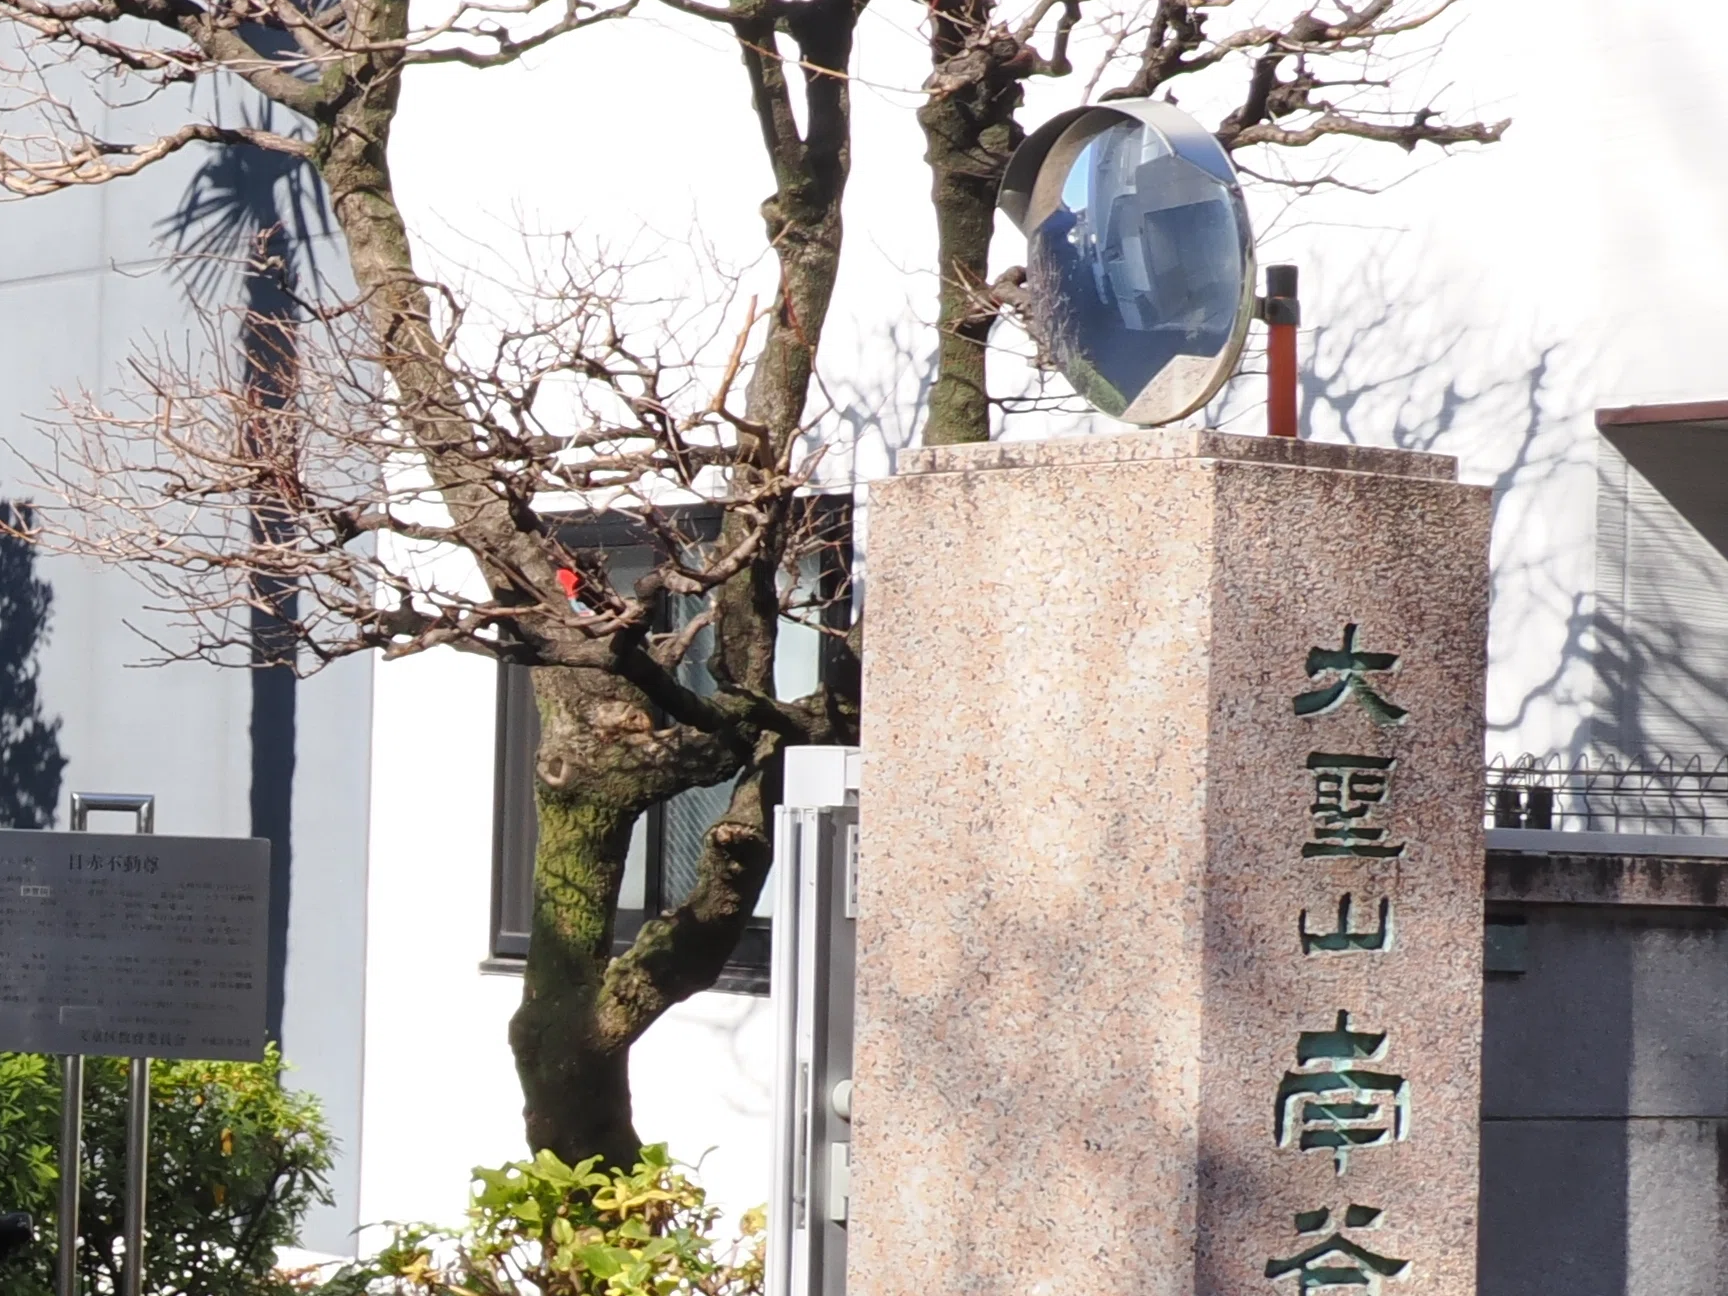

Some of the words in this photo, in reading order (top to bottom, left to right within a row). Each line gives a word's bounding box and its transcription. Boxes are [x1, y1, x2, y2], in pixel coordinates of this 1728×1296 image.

[68, 852, 160, 875] 目赤不動尊
